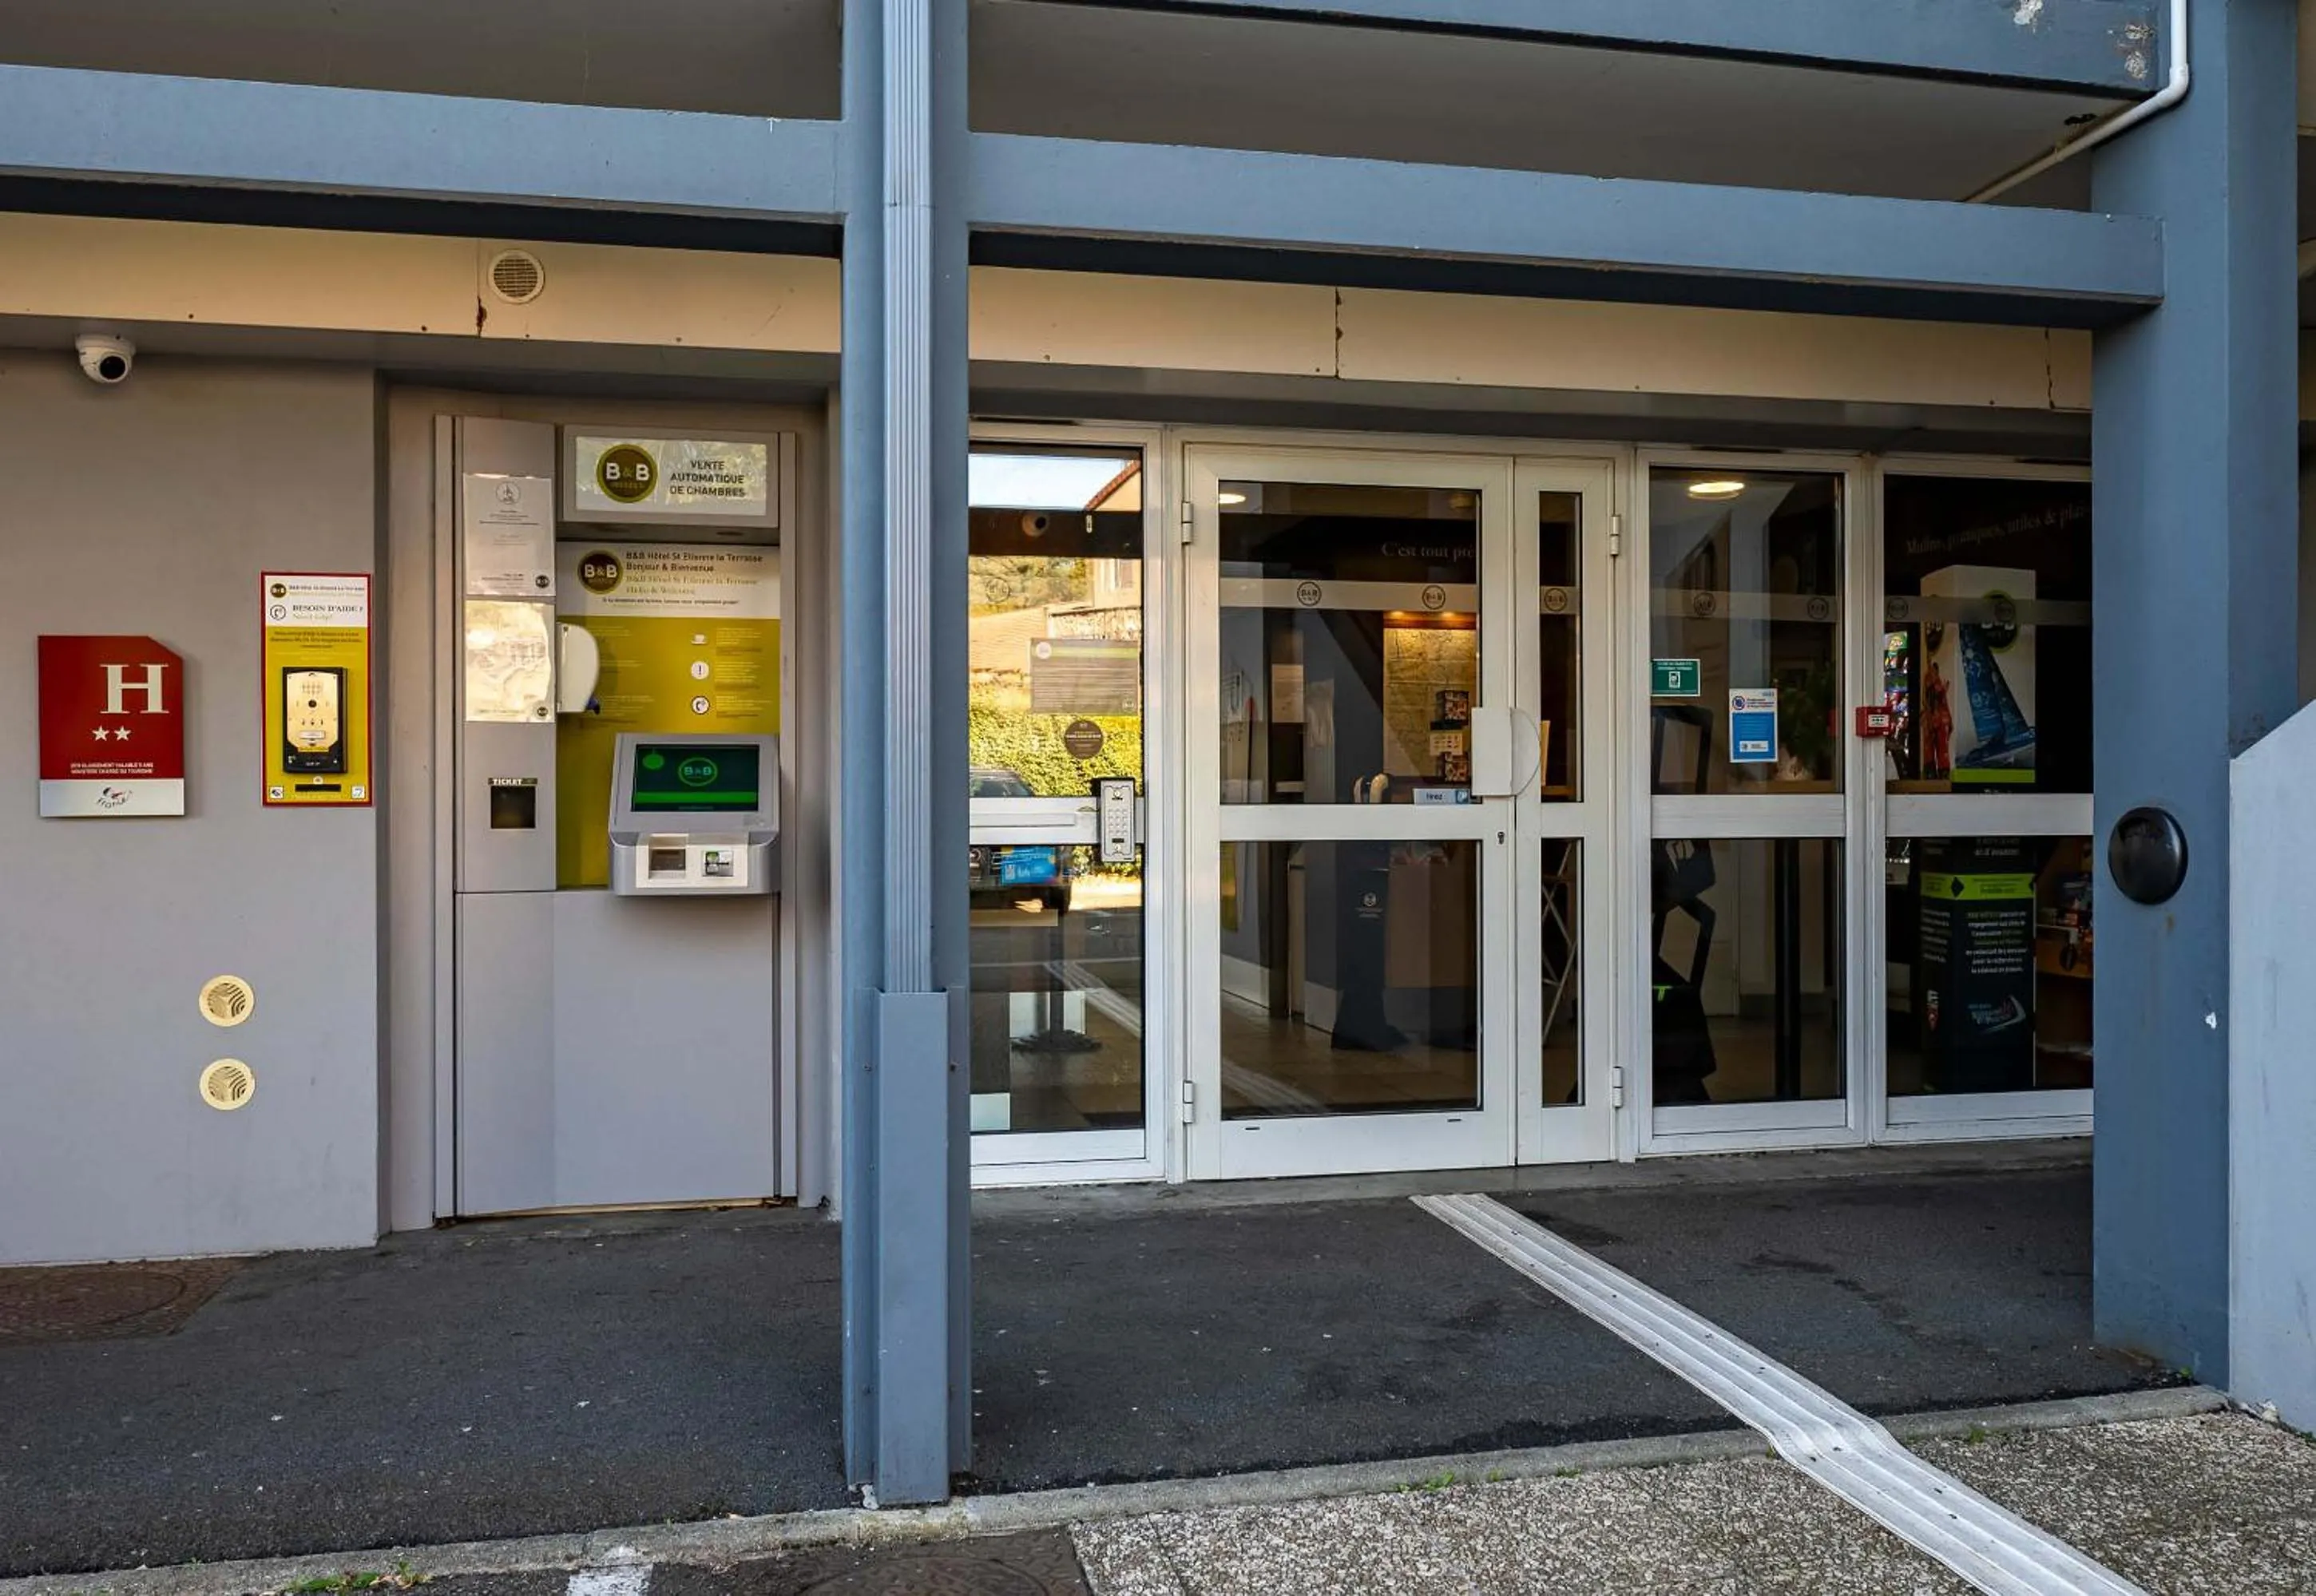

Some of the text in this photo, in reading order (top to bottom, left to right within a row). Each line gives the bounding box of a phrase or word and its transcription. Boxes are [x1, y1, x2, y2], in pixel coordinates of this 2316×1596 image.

[690, 461, 725, 470] VENTE
[669, 473, 745, 485] AUTOMATIQUE
[669, 485, 746, 497] DE CHAMBRES
[1420, 543, 1449, 557] tout
[626, 561, 715, 572] Bonjour & Bienvenue
[99, 663, 170, 715] H
